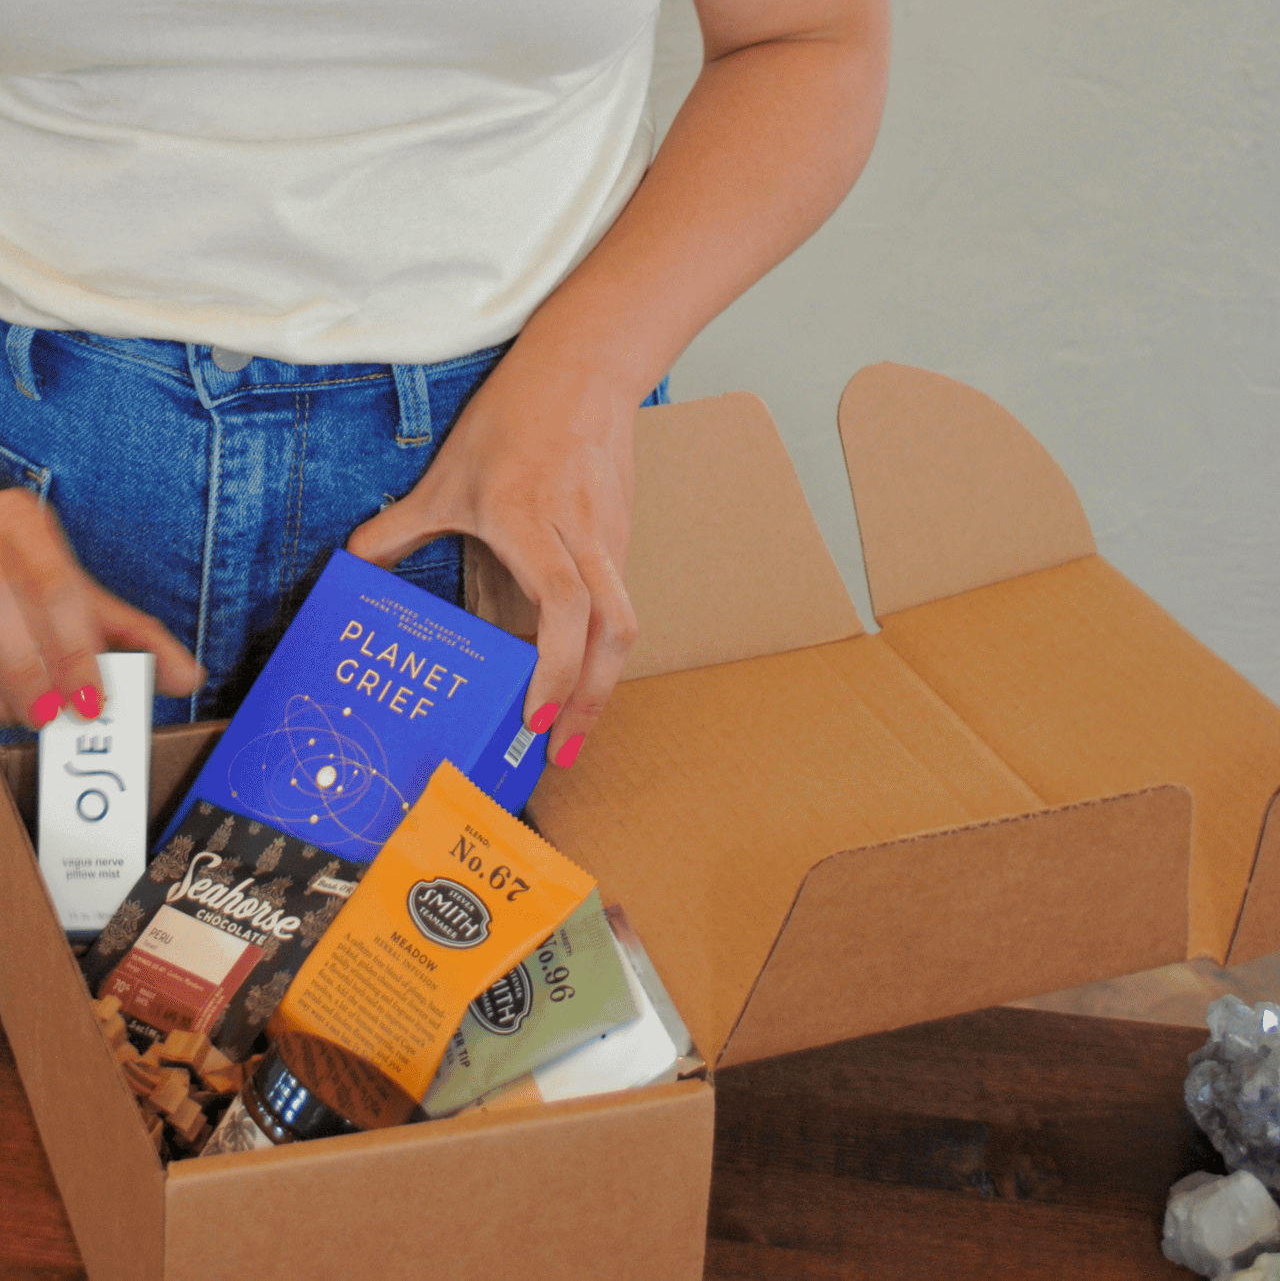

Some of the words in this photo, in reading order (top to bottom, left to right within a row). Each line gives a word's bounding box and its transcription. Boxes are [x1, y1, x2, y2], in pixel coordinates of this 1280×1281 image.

[340, 619, 469, 699] PLANET
[336, 658, 435, 720] GRIEF
[62, 717, 127, 823] OSE
[464, 824, 491, 848] BLEND:
[62, 856, 92, 870] vagus
[95, 857, 124, 867] nerve
[65, 868, 95, 882] pillow
[98, 869, 120, 878] mist
[448, 834, 531, 902] No.67
[165, 851, 302, 940] Seahorse
[418, 888, 479, 938] SMITH
[449, 889, 476, 912] STEVEN
[148, 927, 174, 947] PERU
[196, 908, 268, 946] CHOCOLATE
[418, 905, 458, 939] TEAMAKER
[373, 936, 401, 960] HERBAL
[401, 959, 438, 990] INFUSION
[390, 931, 438, 972] MEADOW
[459, 1048, 471, 1068] TIP
